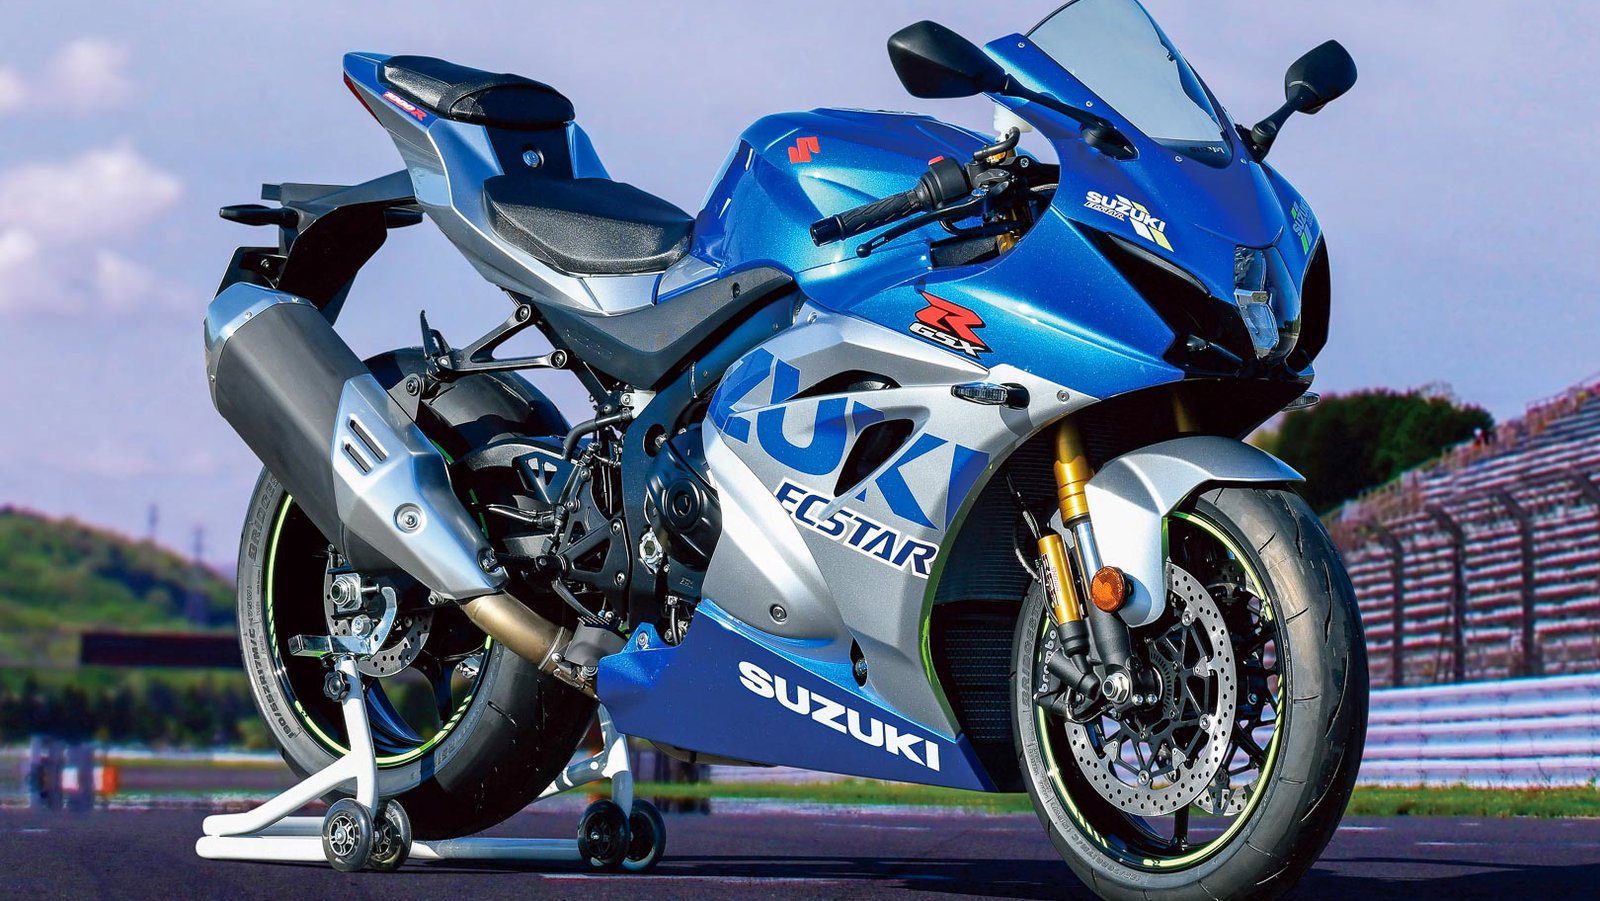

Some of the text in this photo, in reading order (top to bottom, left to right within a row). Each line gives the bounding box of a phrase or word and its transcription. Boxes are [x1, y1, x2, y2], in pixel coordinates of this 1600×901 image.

[1085, 191, 1166, 233] SUZUKI
[909, 322, 985, 357] GSX
[775, 480, 940, 577] ECSTAR
[1039, 629, 1057, 693] brembo
[738, 661, 940, 772] SUZUKI
